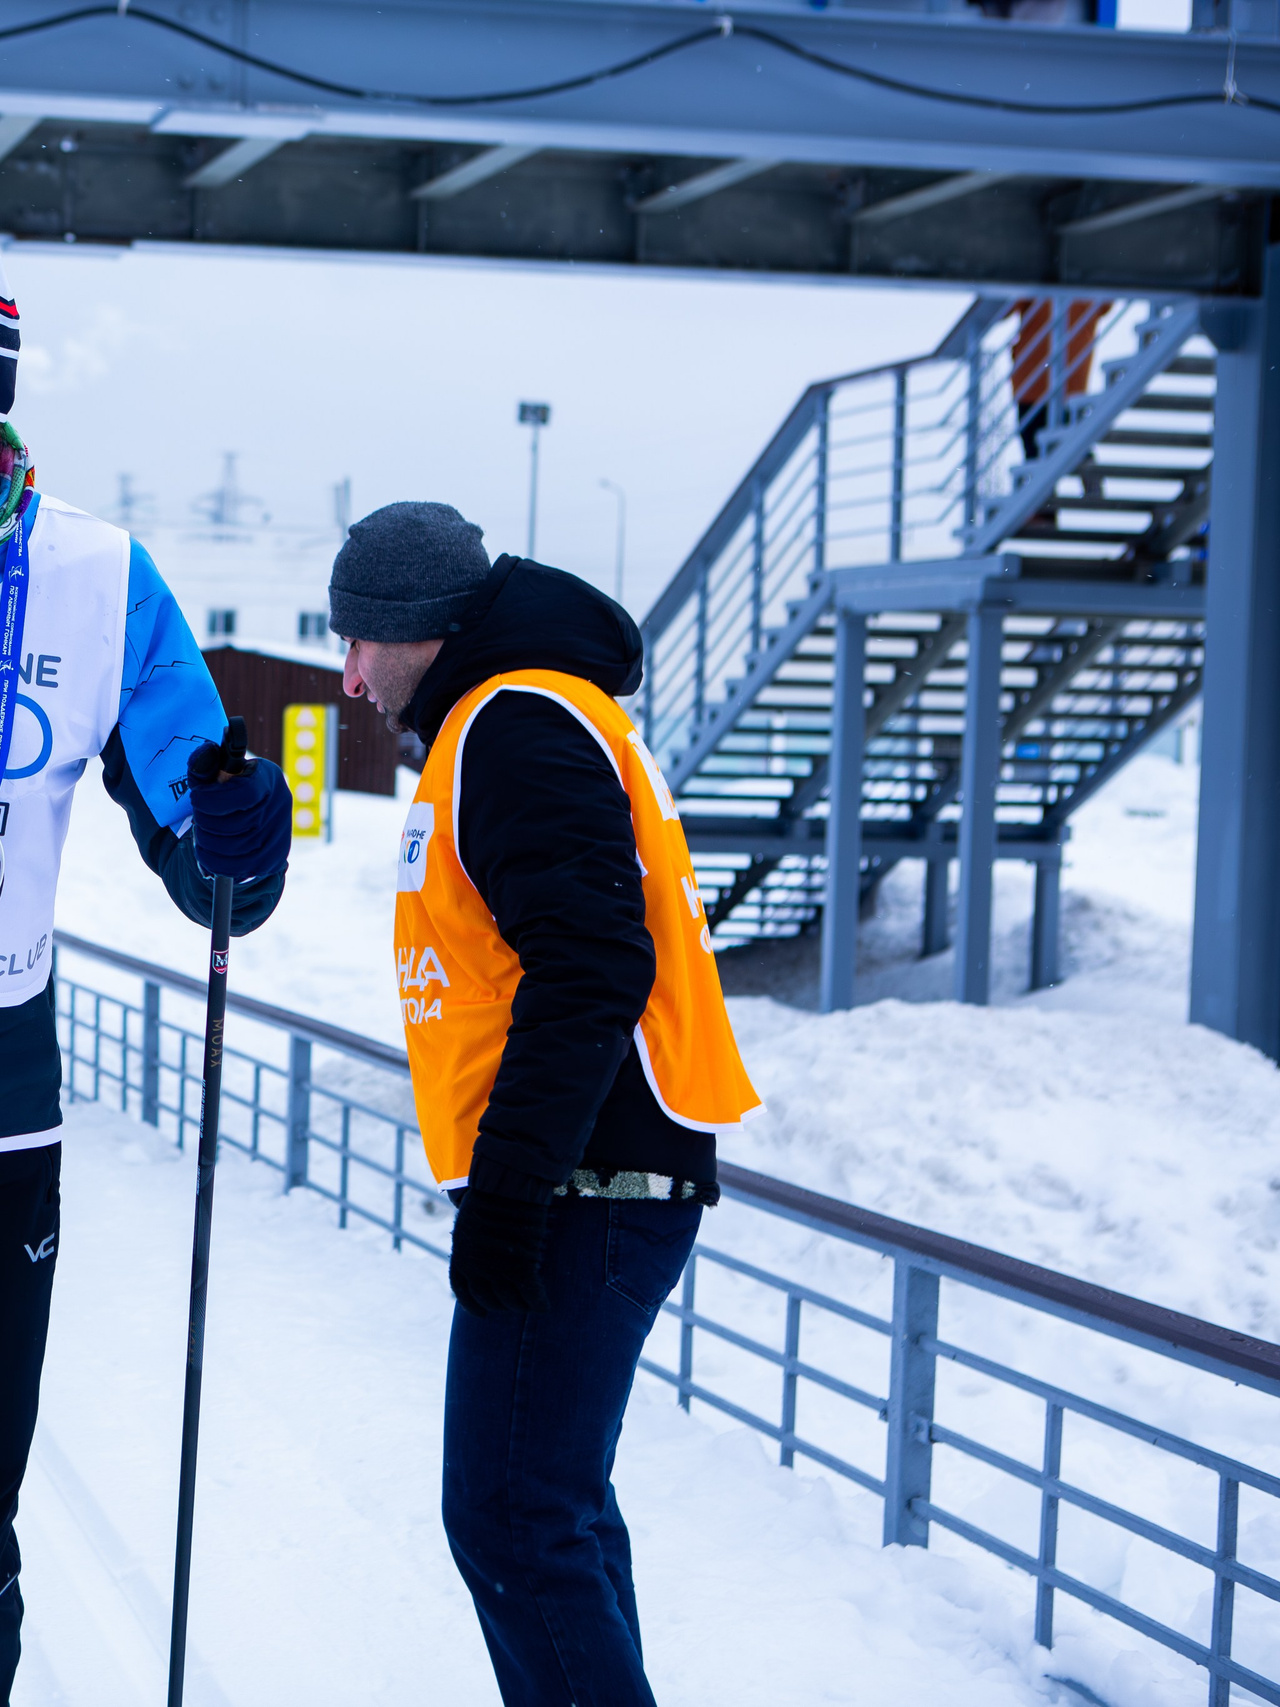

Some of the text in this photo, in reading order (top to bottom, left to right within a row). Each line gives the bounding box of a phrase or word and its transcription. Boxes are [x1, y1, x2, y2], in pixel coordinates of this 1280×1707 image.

[2, 585, 15, 655] ПО ЛЫЖНЫМ ГОНКАМ
[0, 693, 8, 733] ПОДДЕРЖКЕ
[210, 1018, 224, 1067] MOAX
